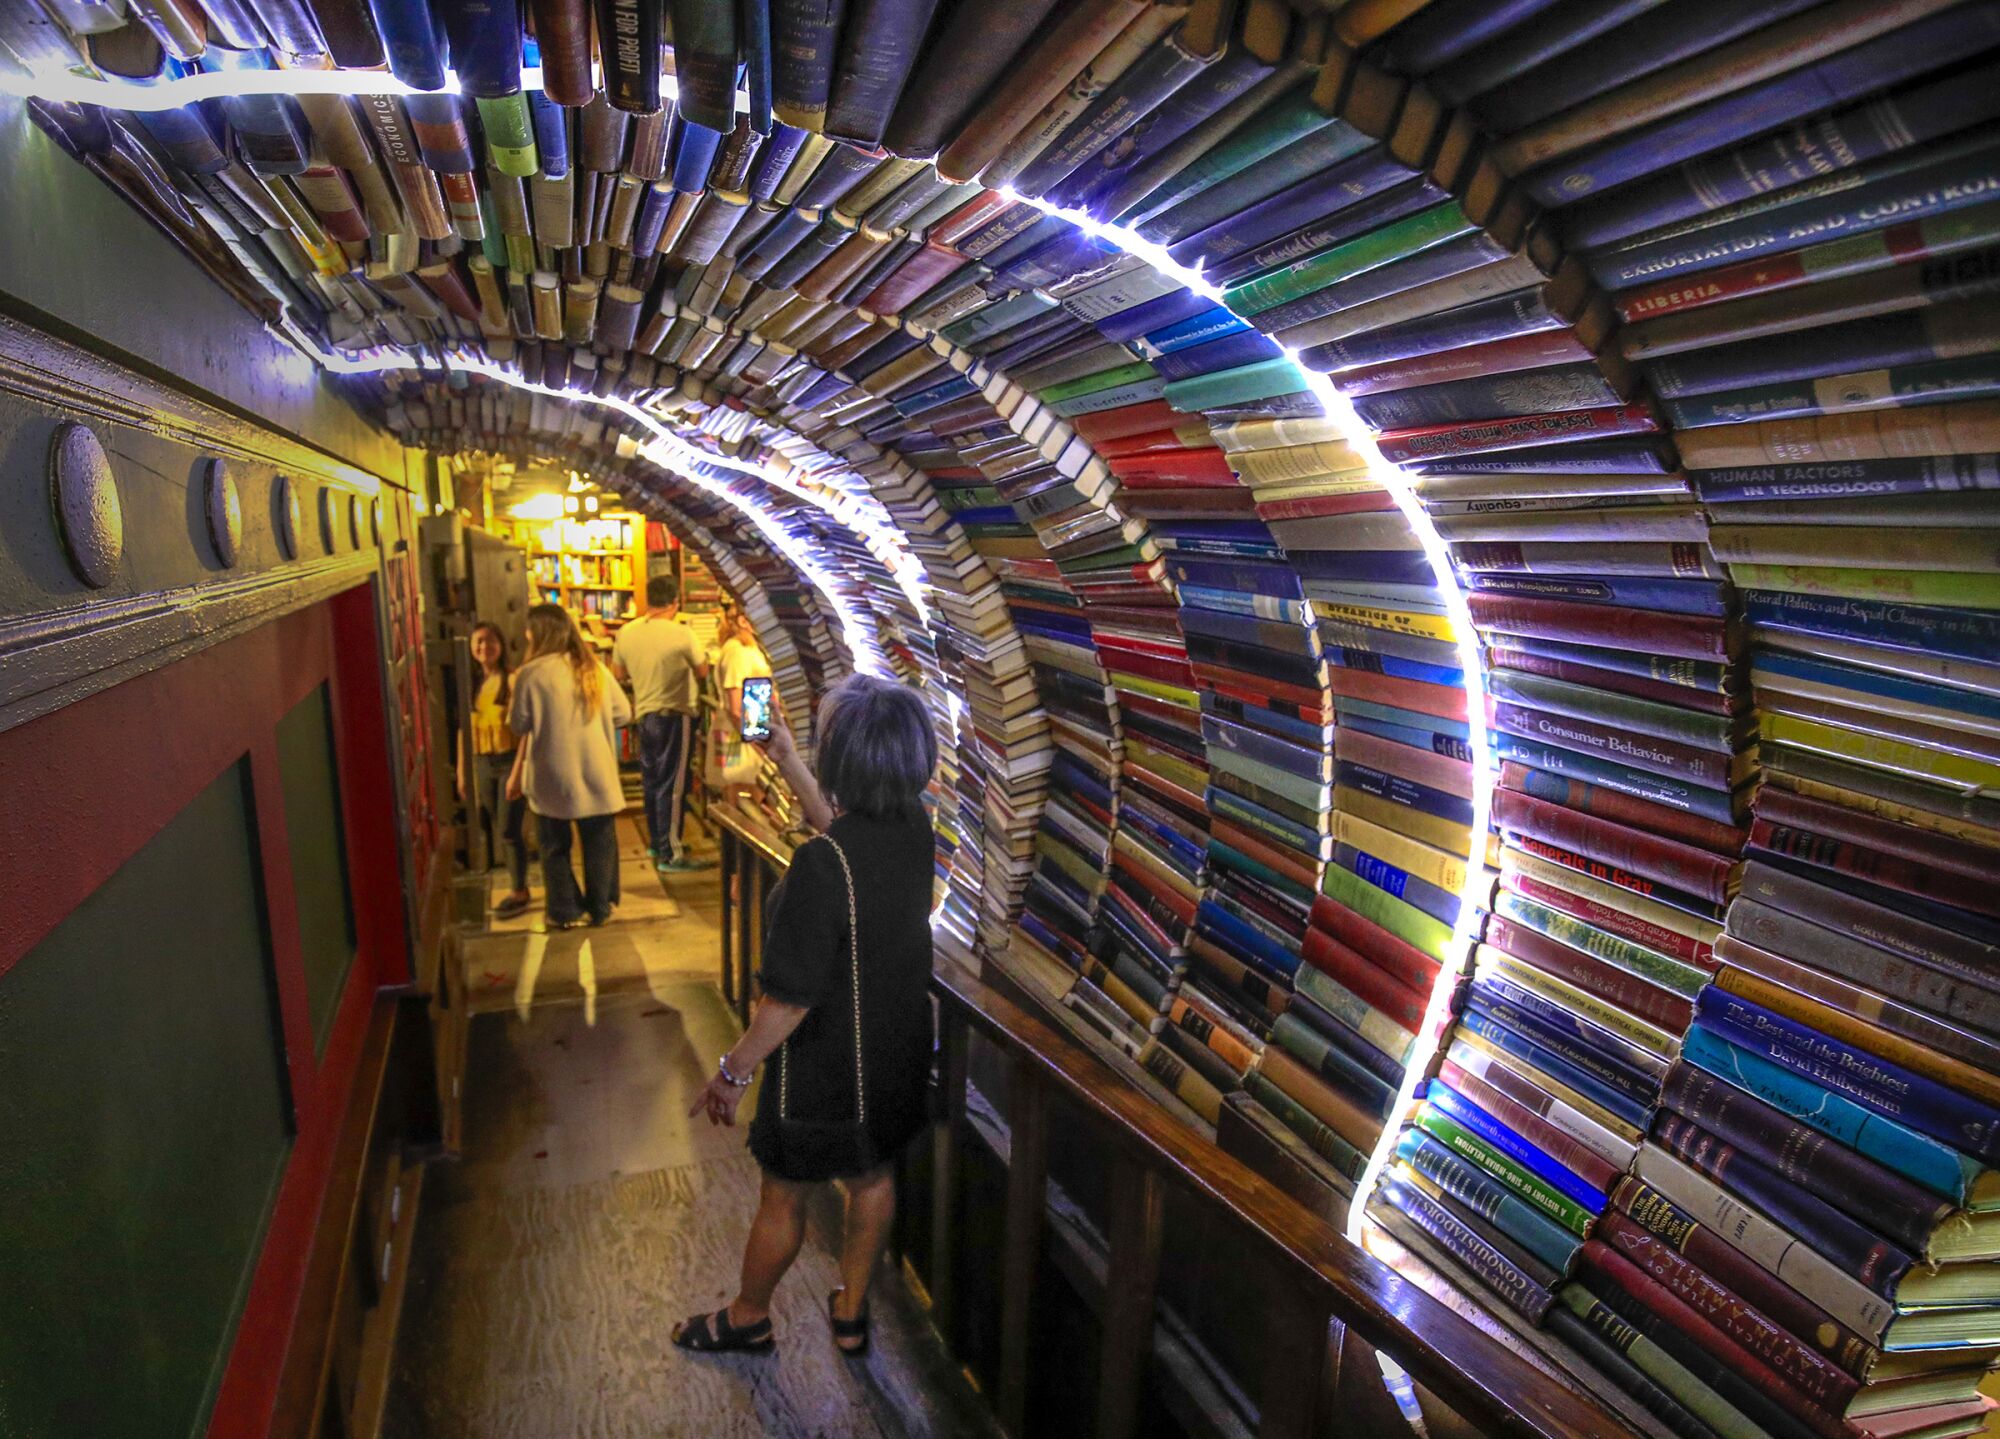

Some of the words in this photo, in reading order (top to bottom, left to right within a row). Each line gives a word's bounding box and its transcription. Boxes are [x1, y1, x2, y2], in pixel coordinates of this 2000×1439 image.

[616, 11, 638, 35] FOR
[617, 36, 641, 75] PROFIT
[1621, 231, 1775, 280] EXHORTATION
[1787, 216, 1847, 240] AND
[1636, 283, 1721, 313] LIBERIA
[1507, 418, 1542, 435] Soviet
[1542, 411, 1597, 431] Post-War
[1433, 464, 1454, 472] ACT
[1710, 469, 1776, 483] HUMAN
[1784, 464, 1866, 480] FACTORS
[1743, 486, 1764, 497] IN
[1770, 479, 1898, 496] TECHNOLOGY
[1466, 500, 1522, 513] equality
[1516, 580, 1570, 594] Navigators
[1328, 603, 1388, 622] DYNAMICS
[1395, 611, 1411, 626] OF
[1749, 590, 1782, 607] Rural
[1784, 594, 1824, 613] Politics
[1825, 601, 1848, 616] and
[1887, 607, 1938, 633] Change
[1539, 720, 1606, 748] Consumer
[1608, 736, 1675, 766] Behavior
[1522, 836, 1587, 873] Generals
[1591, 863, 1609, 881] in
[1612, 868, 1654, 897] Gray
[1586, 901, 1612, 919] Today
[1612, 913, 1646, 932] Society
[1594, 914, 1649, 945] Expression
[1647, 925, 1671, 942] Arab
[1491, 1006, 1522, 1033] Economy
[1588, 1003, 1601, 1017] AND
[1602, 1011, 1633, 1033] POLITICAL
[1634, 1026, 1664, 1048] OPINION
[1728, 1002, 1752, 1025] The
[1752, 1014, 1784, 1039] Best
[1786, 1029, 1815, 1051] and
[1814, 1040, 1838, 1063] the
[1838, 1051, 1910, 1096] Brightest
[1562, 1045, 1617, 1083] Contemporary
[1617, 1075, 1633, 1091] The
[1769, 1043, 1811, 1072] David
[1813, 1061, 1903, 1116] Halberstam
[1454, 1136, 1486, 1163] RELATIONS
[1486, 1154, 1523, 1189] SINO-INDIAN
[1521, 1182, 1532, 1193] OF
[1531, 1188, 1561, 1214] HISTORY
[1559, 1209, 1569, 1218] A
[1636, 1191, 1659, 1225] CONSUMER
[1412, 1212, 1438, 1236] THE
[1647, 1199, 1671, 1233] ECONOMIC
[1656, 1209, 1674, 1233] ORDER
[1421, 1198, 1528, 1291] CONQUISTADORS
[1441, 1236, 1458, 1251] OF
[1460, 1254, 1490, 1278] LAST
[1646, 1260, 1664, 1275] OF
[1491, 1279, 1520, 1302] THE
[1649, 1248, 1746, 1320] AMERICA
[1672, 1277, 1718, 1314] ATLAS
[1699, 1275, 1727, 1297] ECONOMIC
[1726, 1317, 1826, 1398] HISTORICAL
[1753, 1323, 1828, 1382] LATIN
